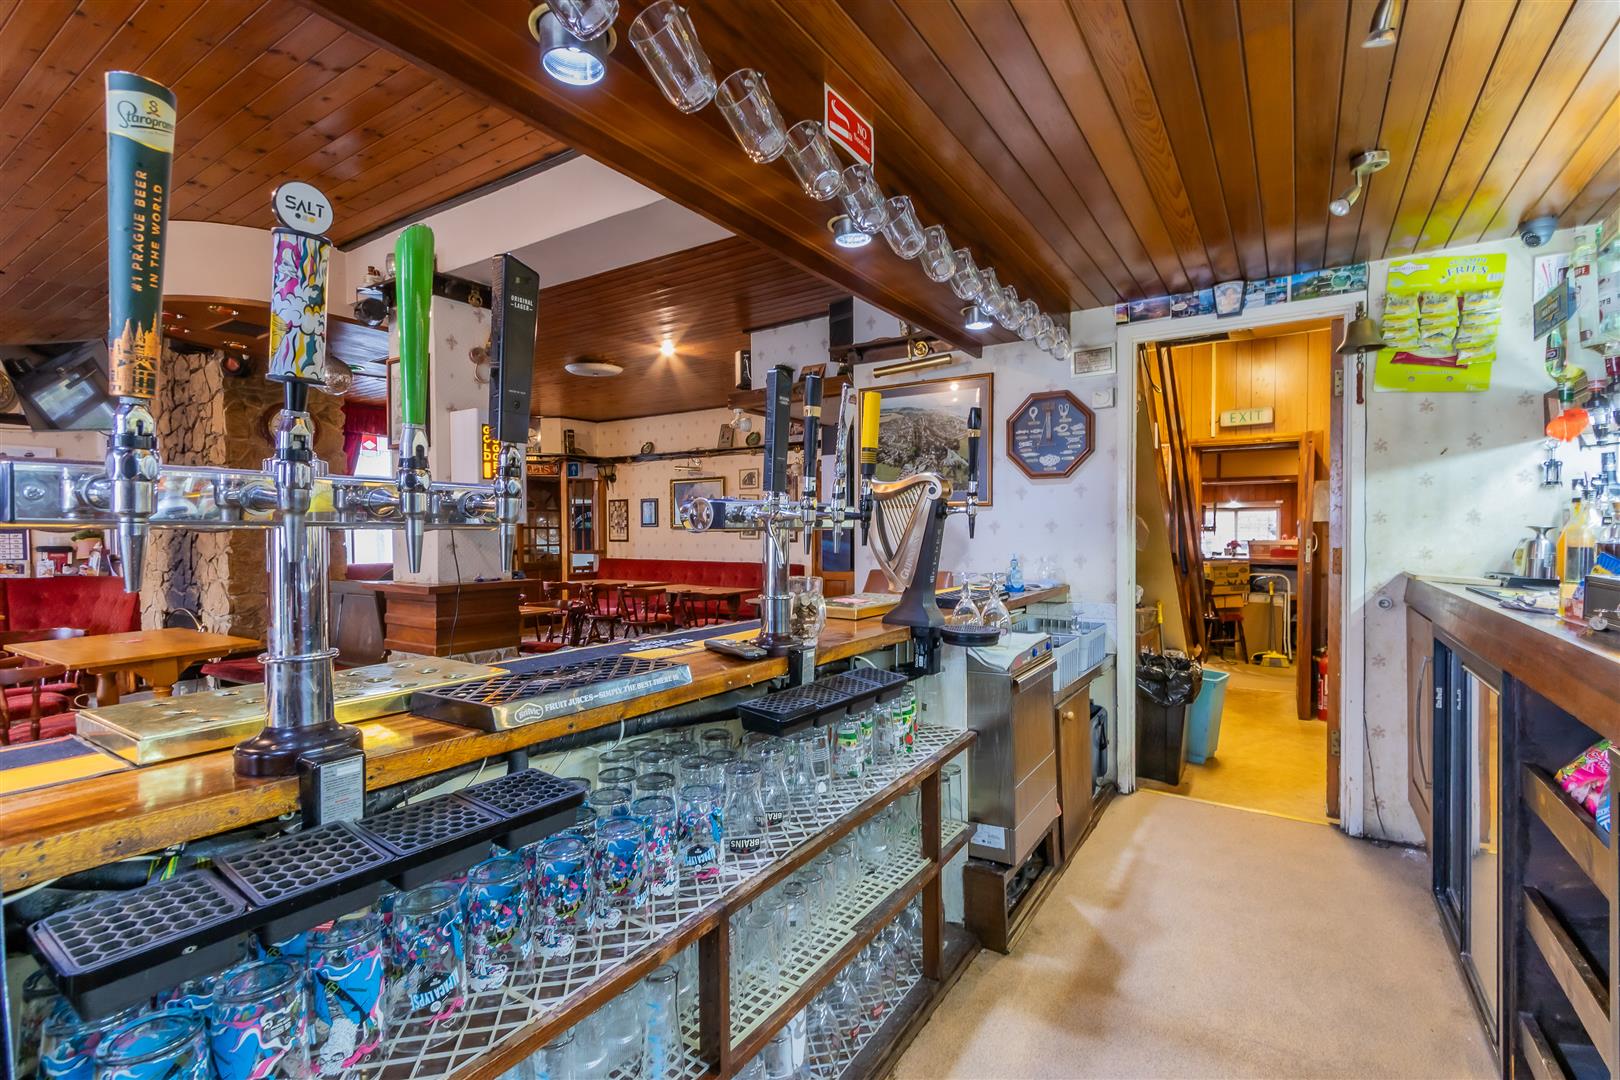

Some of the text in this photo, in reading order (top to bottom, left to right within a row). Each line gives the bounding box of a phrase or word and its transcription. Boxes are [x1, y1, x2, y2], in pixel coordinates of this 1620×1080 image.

[134, 170, 148, 208] BEER
[285, 194, 325, 218] SALT
[131, 213, 146, 271] PRAGUE
[149, 184, 163, 288] IN THE WORLD
[510, 295, 533, 306] ORIGINAL
[514, 302, 530, 311] LAGER
[1230, 409, 1264, 423] EXIT
[545, 700, 567, 712] FRUIT
[598, 687, 623, 699] SIMPLY
[623, 683, 638, 693] THE
[637, 679, 653, 690] BEST
[730, 837, 760, 848] BRAINS
